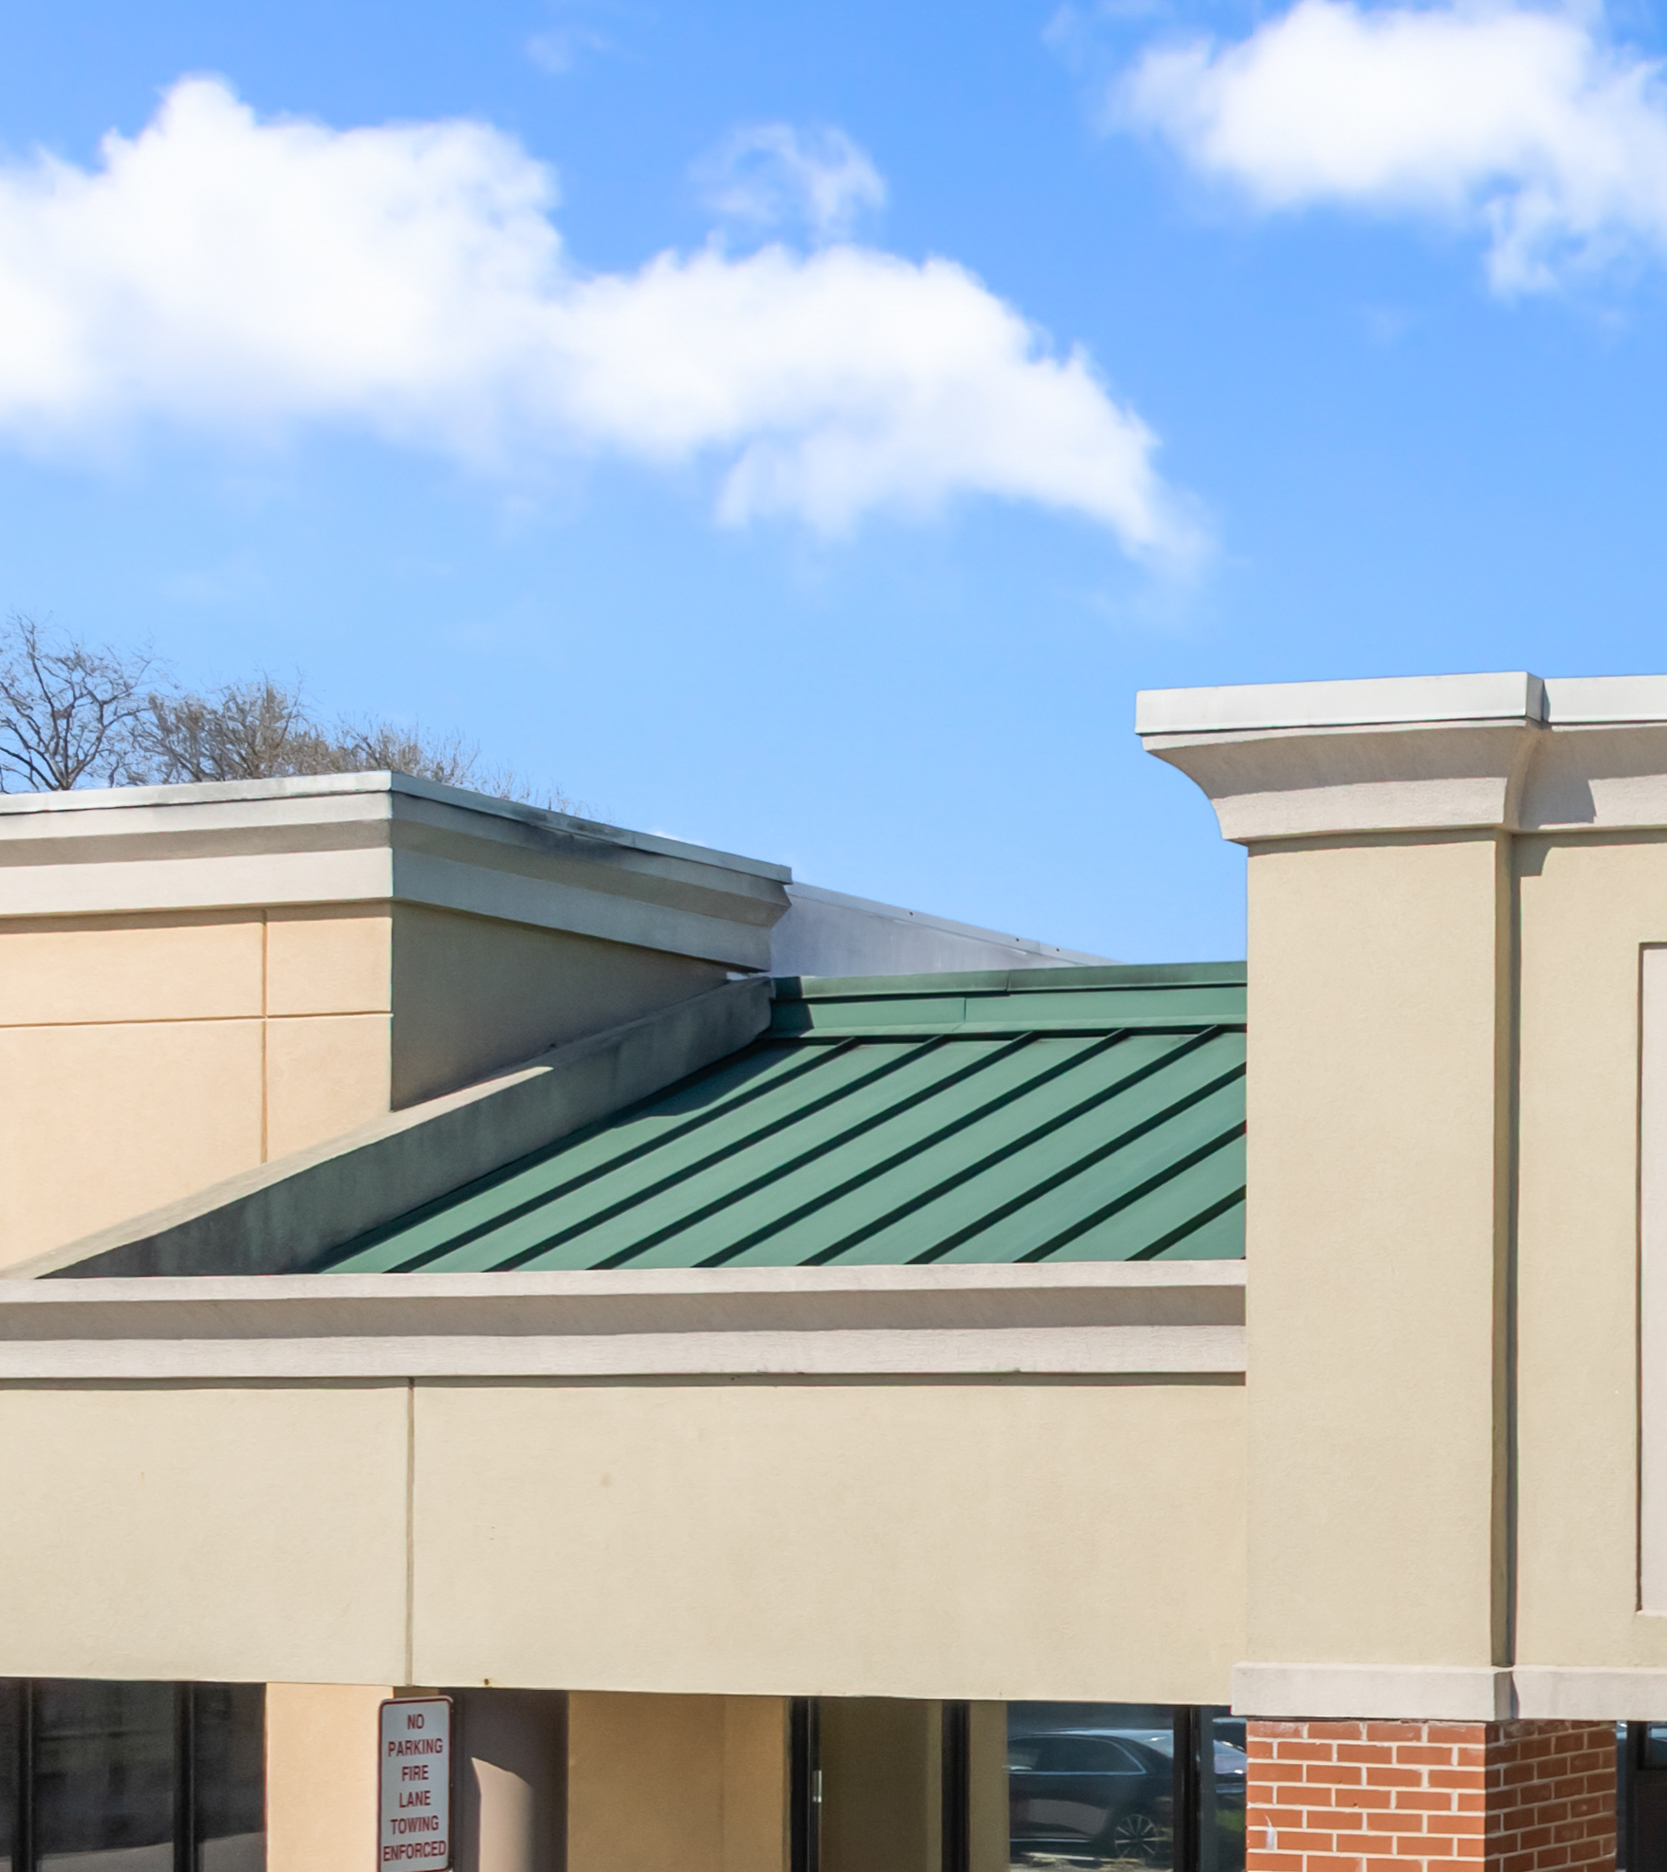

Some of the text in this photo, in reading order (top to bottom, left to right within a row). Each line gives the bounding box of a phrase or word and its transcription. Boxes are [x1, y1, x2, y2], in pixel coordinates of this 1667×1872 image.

[407, 1713, 424, 1730] NO
[388, 1738, 443, 1757] PARKING
[402, 1765, 429, 1782] FIRE
[399, 1790, 431, 1808] LANE
[390, 1815, 439, 1834] TOWING
[383, 1840, 446, 1862] ENFORCED
